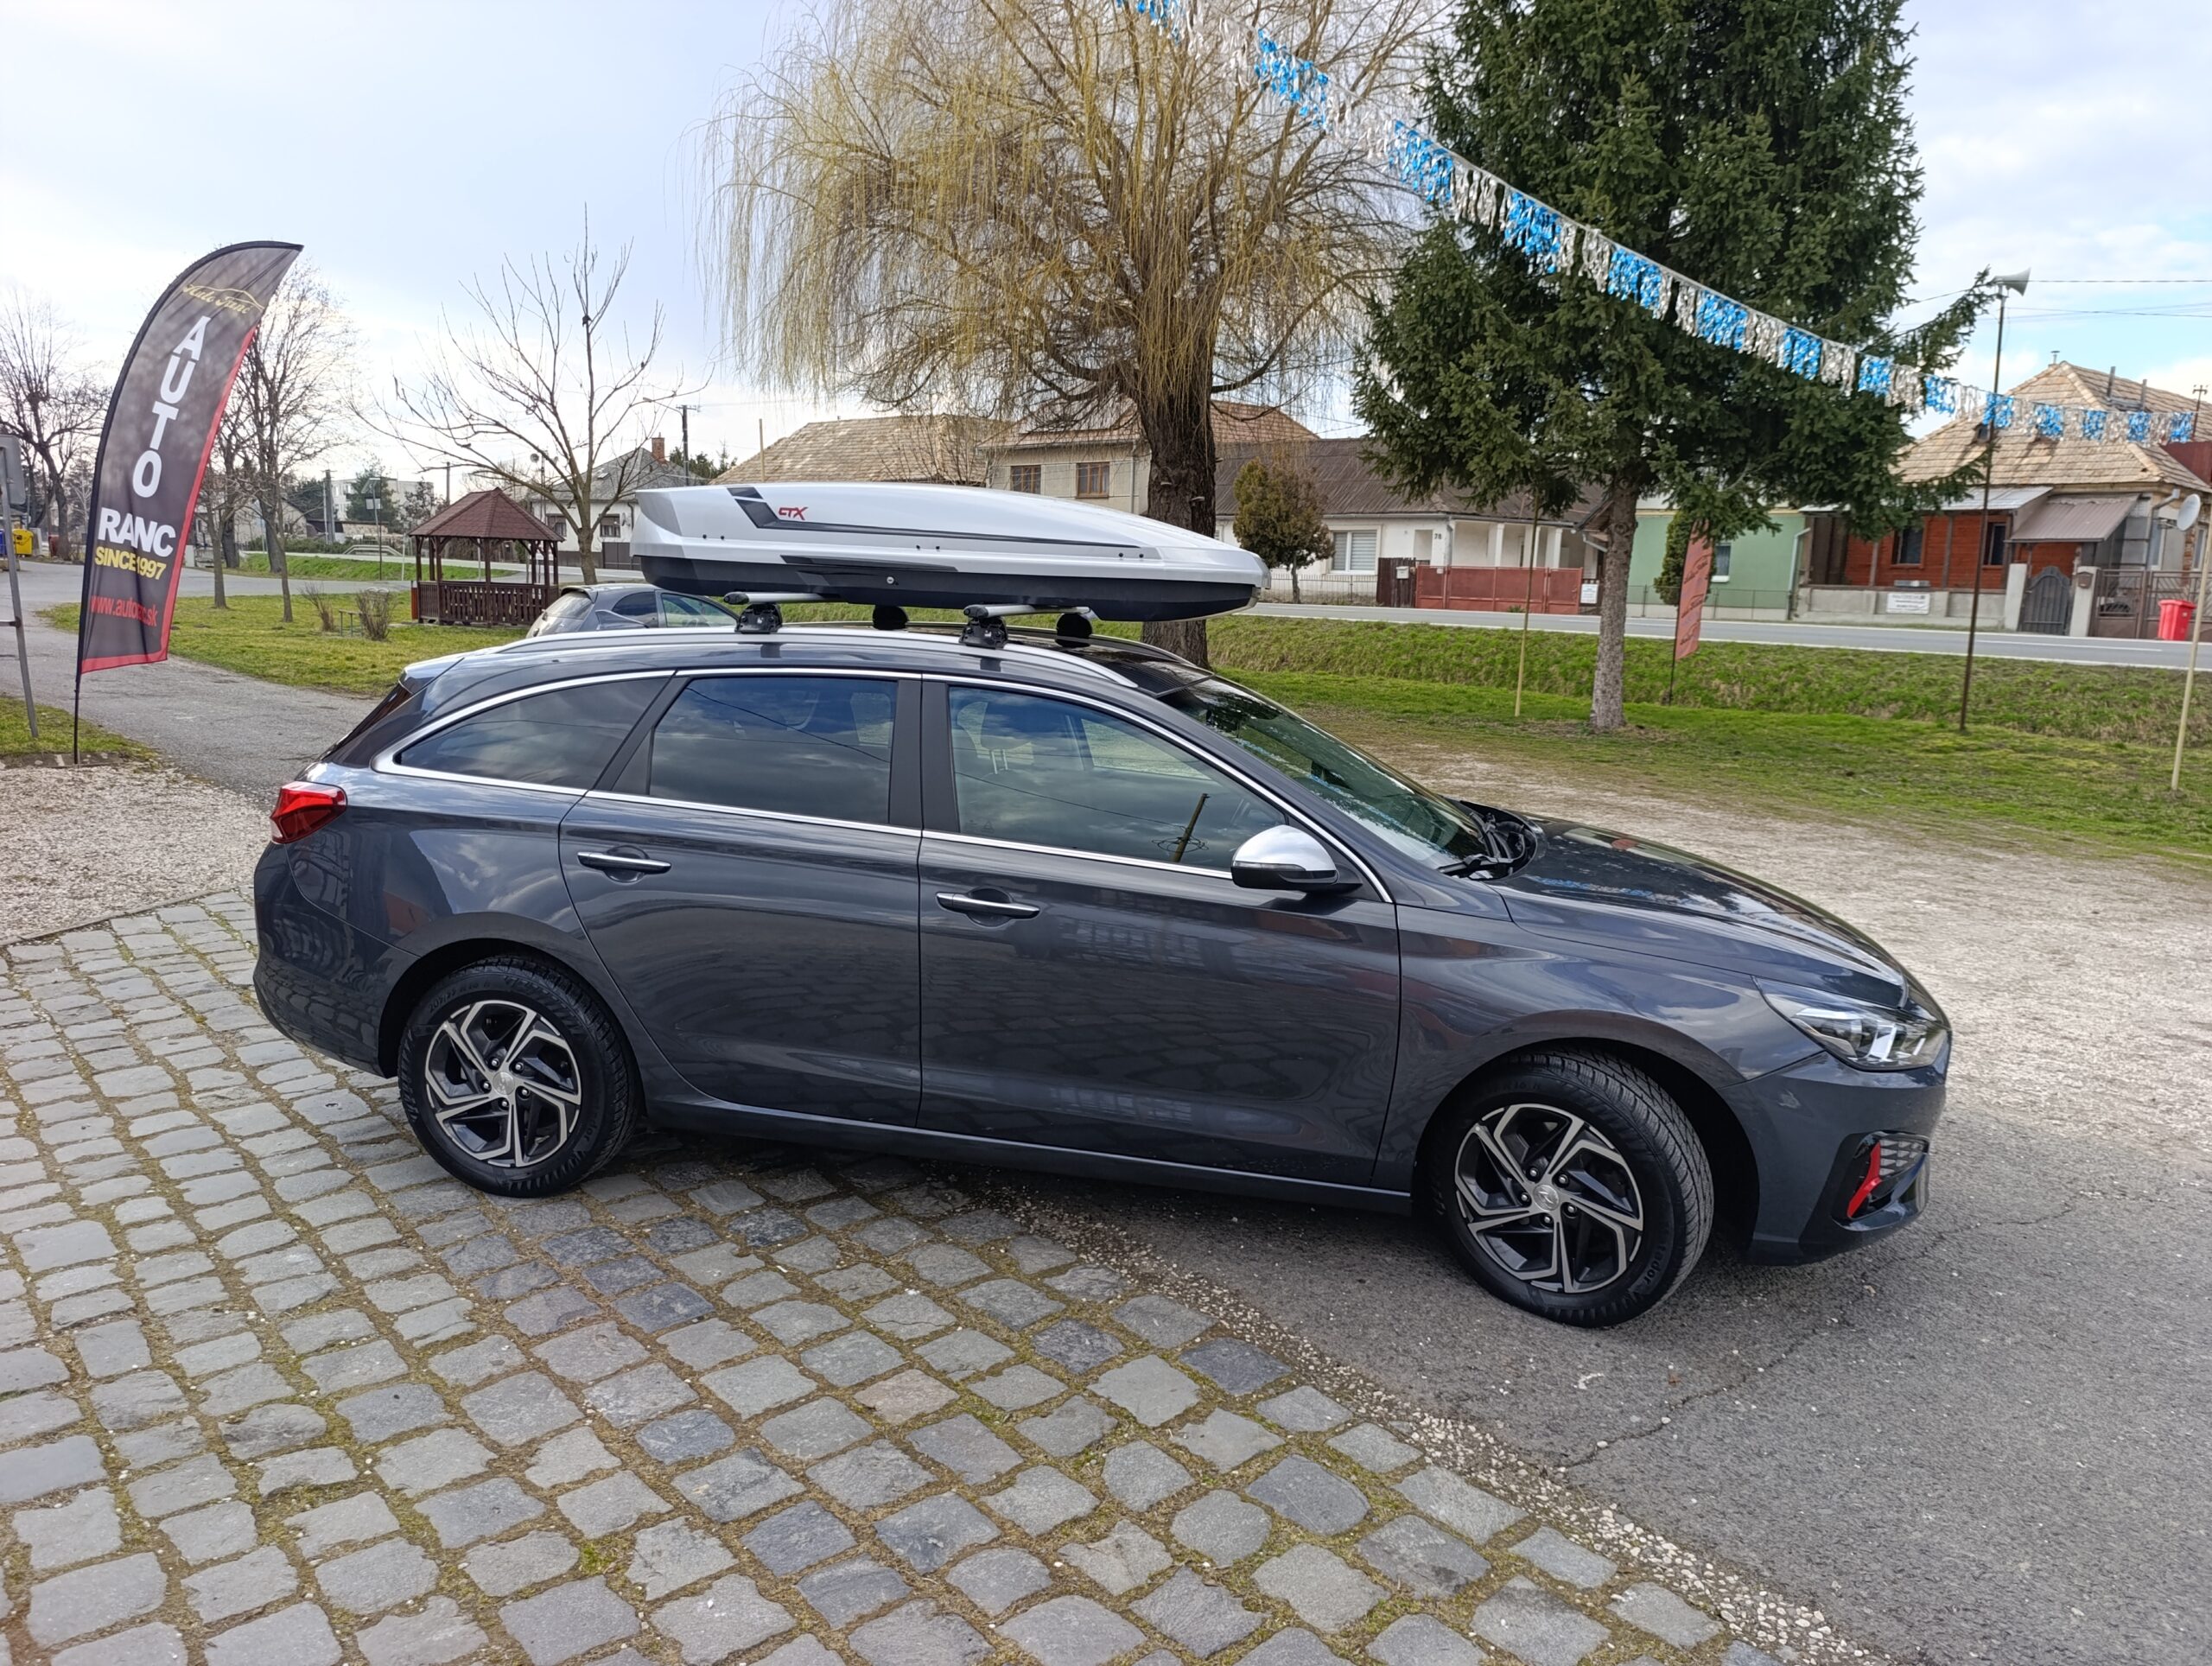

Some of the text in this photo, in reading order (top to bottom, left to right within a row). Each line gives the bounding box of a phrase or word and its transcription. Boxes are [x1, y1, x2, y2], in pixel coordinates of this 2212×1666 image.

[132, 315, 211, 498] AUTO
[98, 507, 176, 557] RANC
[95, 546, 167, 580] SINCE 1997
